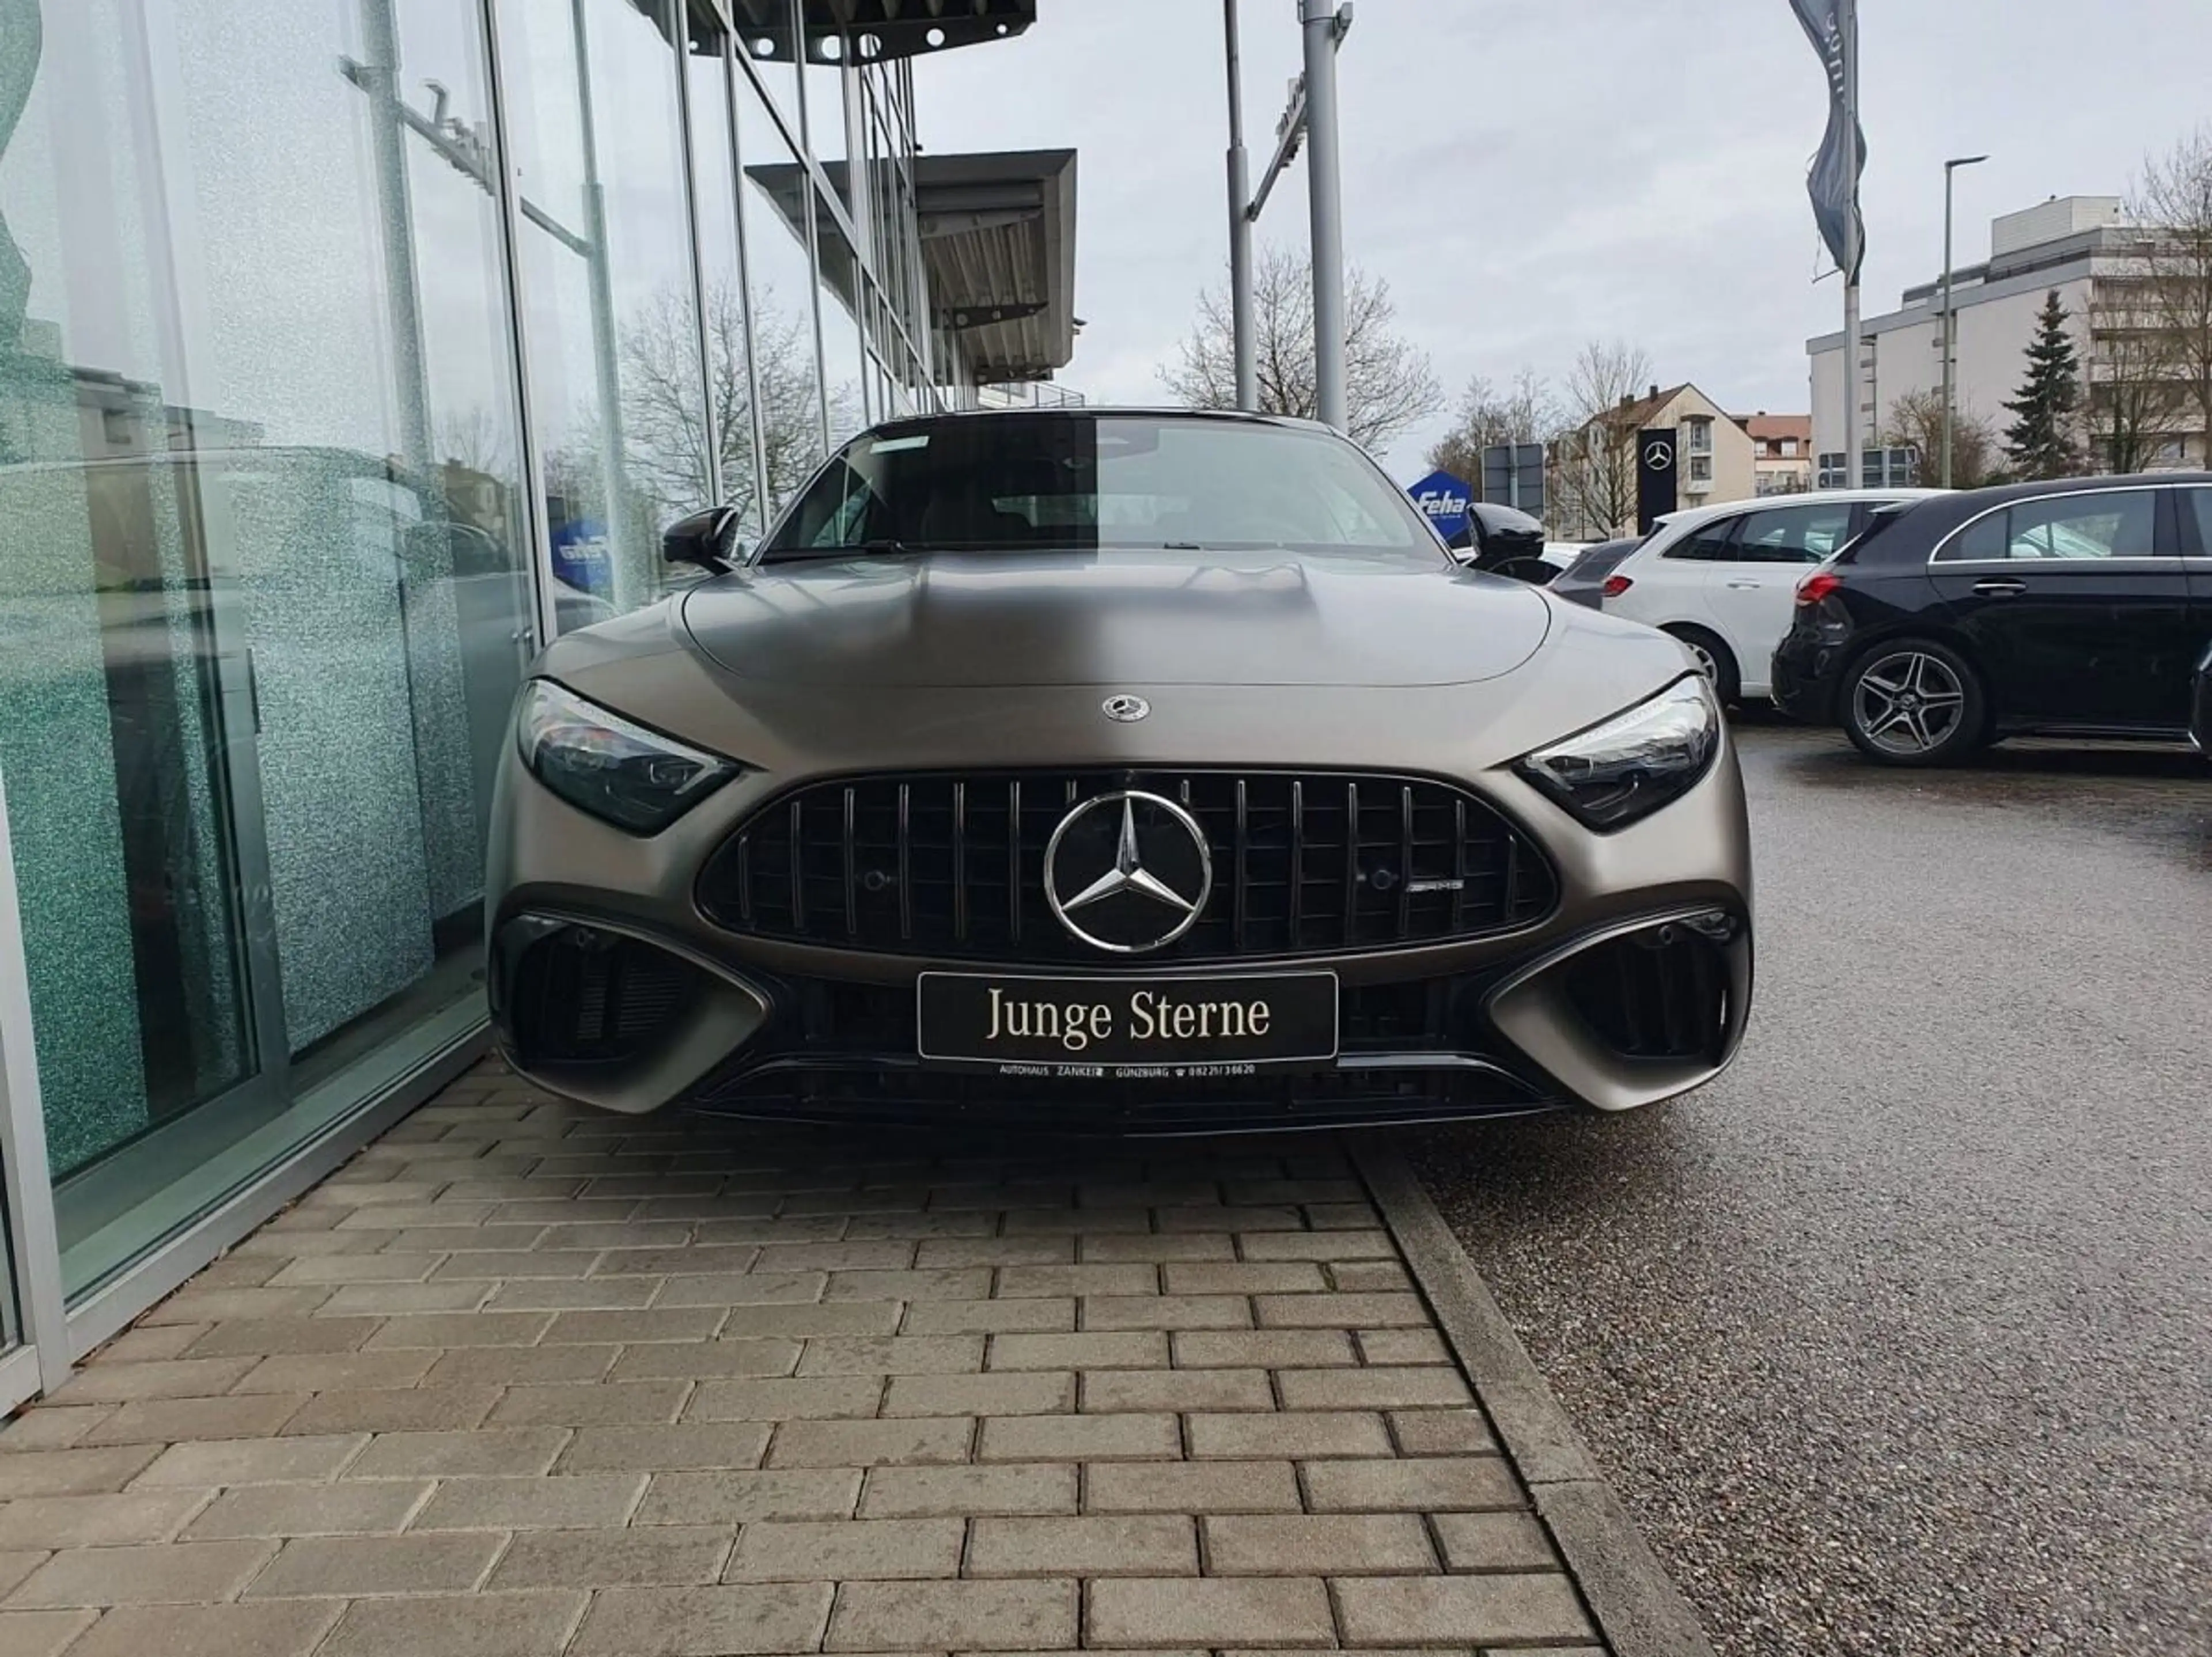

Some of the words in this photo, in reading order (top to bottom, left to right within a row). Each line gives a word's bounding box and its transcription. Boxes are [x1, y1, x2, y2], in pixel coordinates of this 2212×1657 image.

[1419, 490, 1466, 514] Feha
[986, 987, 1112, 1051] Junge
[1130, 991, 1270, 1040] Sterne
[999, 1064, 1049, 1076] AUTOHAUS
